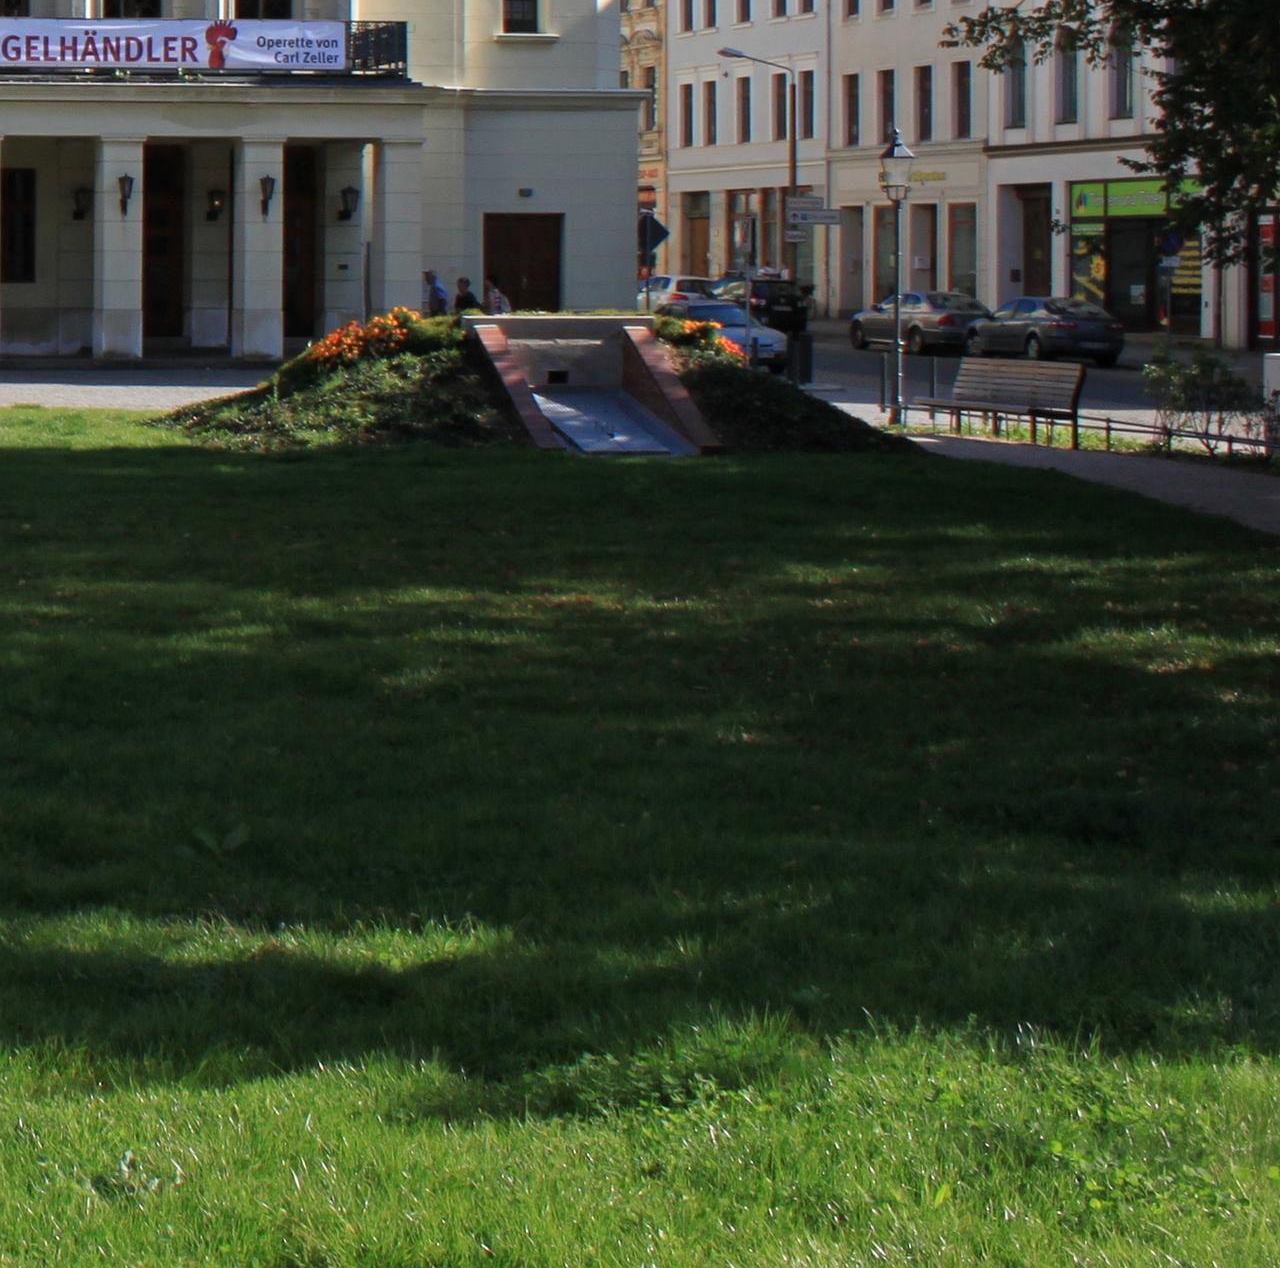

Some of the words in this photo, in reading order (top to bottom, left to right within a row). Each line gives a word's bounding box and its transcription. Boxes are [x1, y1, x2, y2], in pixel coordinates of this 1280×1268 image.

[256, 35, 313, 50] Operette
[316, 39, 338, 48] von
[274, 51, 300, 64] Carl
[303, 51, 339, 64] Zeller
